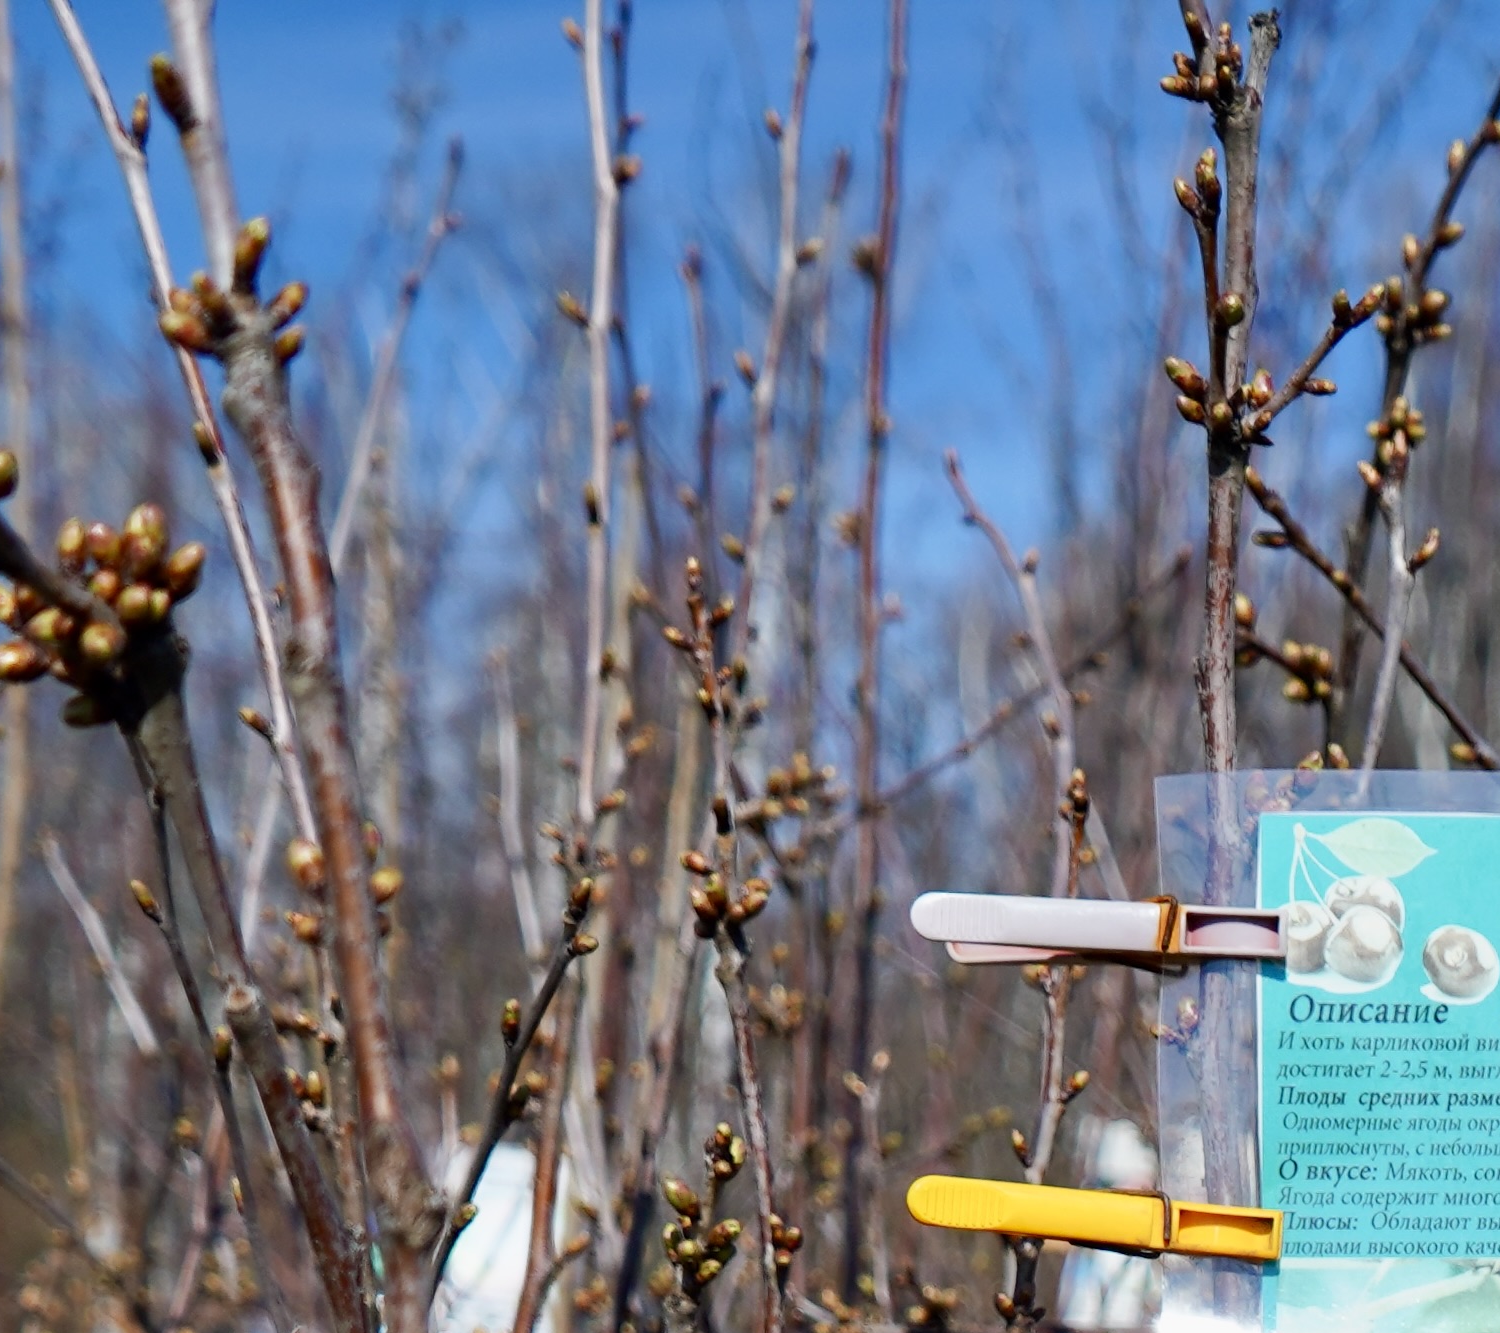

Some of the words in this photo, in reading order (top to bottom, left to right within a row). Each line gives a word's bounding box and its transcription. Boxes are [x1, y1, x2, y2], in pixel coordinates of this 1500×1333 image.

[1289, 994, 1449, 1024] Описание
[1277, 1031, 1296, 1050] И
[1300, 1035, 1345, 1051] хоть
[1350, 1033, 1470, 1056] карликовой
[1276, 1063, 1375, 1081] достигает
[1380, 1060, 1428, 1080] 2-2,5
[1433, 1066, 1452, 1080] м,
[1278, 1086, 1346, 1106] Плоды
[1359, 1091, 1440, 1111] средних
[1283, 1112, 1401, 1135] Одномерные
[1407, 1117, 1462, 1132] ягоды
[1278, 1141, 1410, 1161] приплюснуты,
[1415, 1143, 1424, 1156] с
[1278, 1158, 1298, 1181] О
[1305, 1163, 1378, 1187] вкусе:
[1385, 1161, 1468, 1183] Мякоть,
[1279, 1187, 1335, 1208] Ягода
[1341, 1190, 1438, 1211] содержит
[1371, 1211, 1471, 1232] Обладают
[1368, 1242, 1459, 1255] высокого
